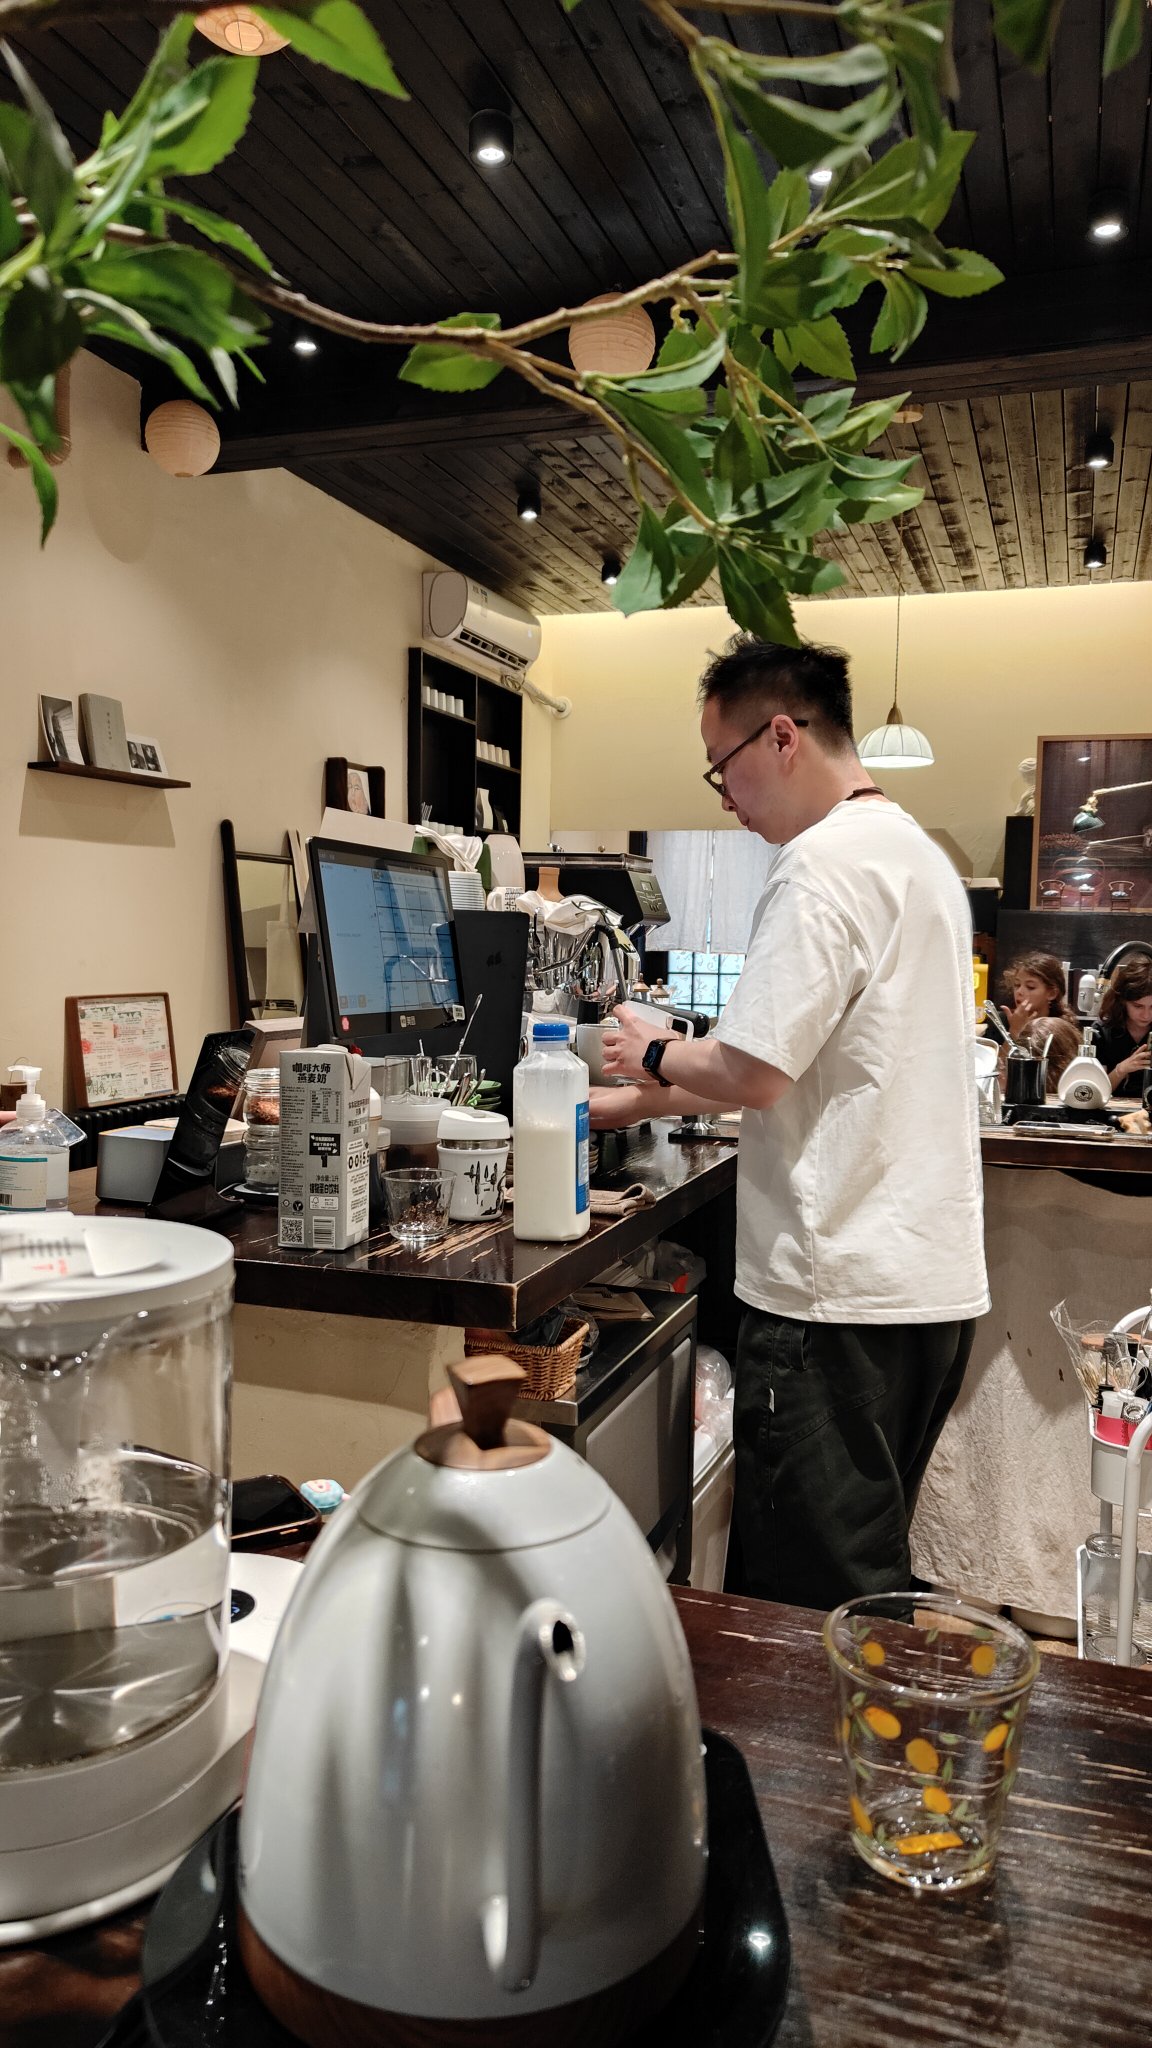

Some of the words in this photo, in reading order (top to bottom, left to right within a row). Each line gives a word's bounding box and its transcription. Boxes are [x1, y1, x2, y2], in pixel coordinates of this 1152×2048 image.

[292, 1062, 331, 1074] 咖啡大师
[297, 1072, 327, 1084] 燕麦奶
